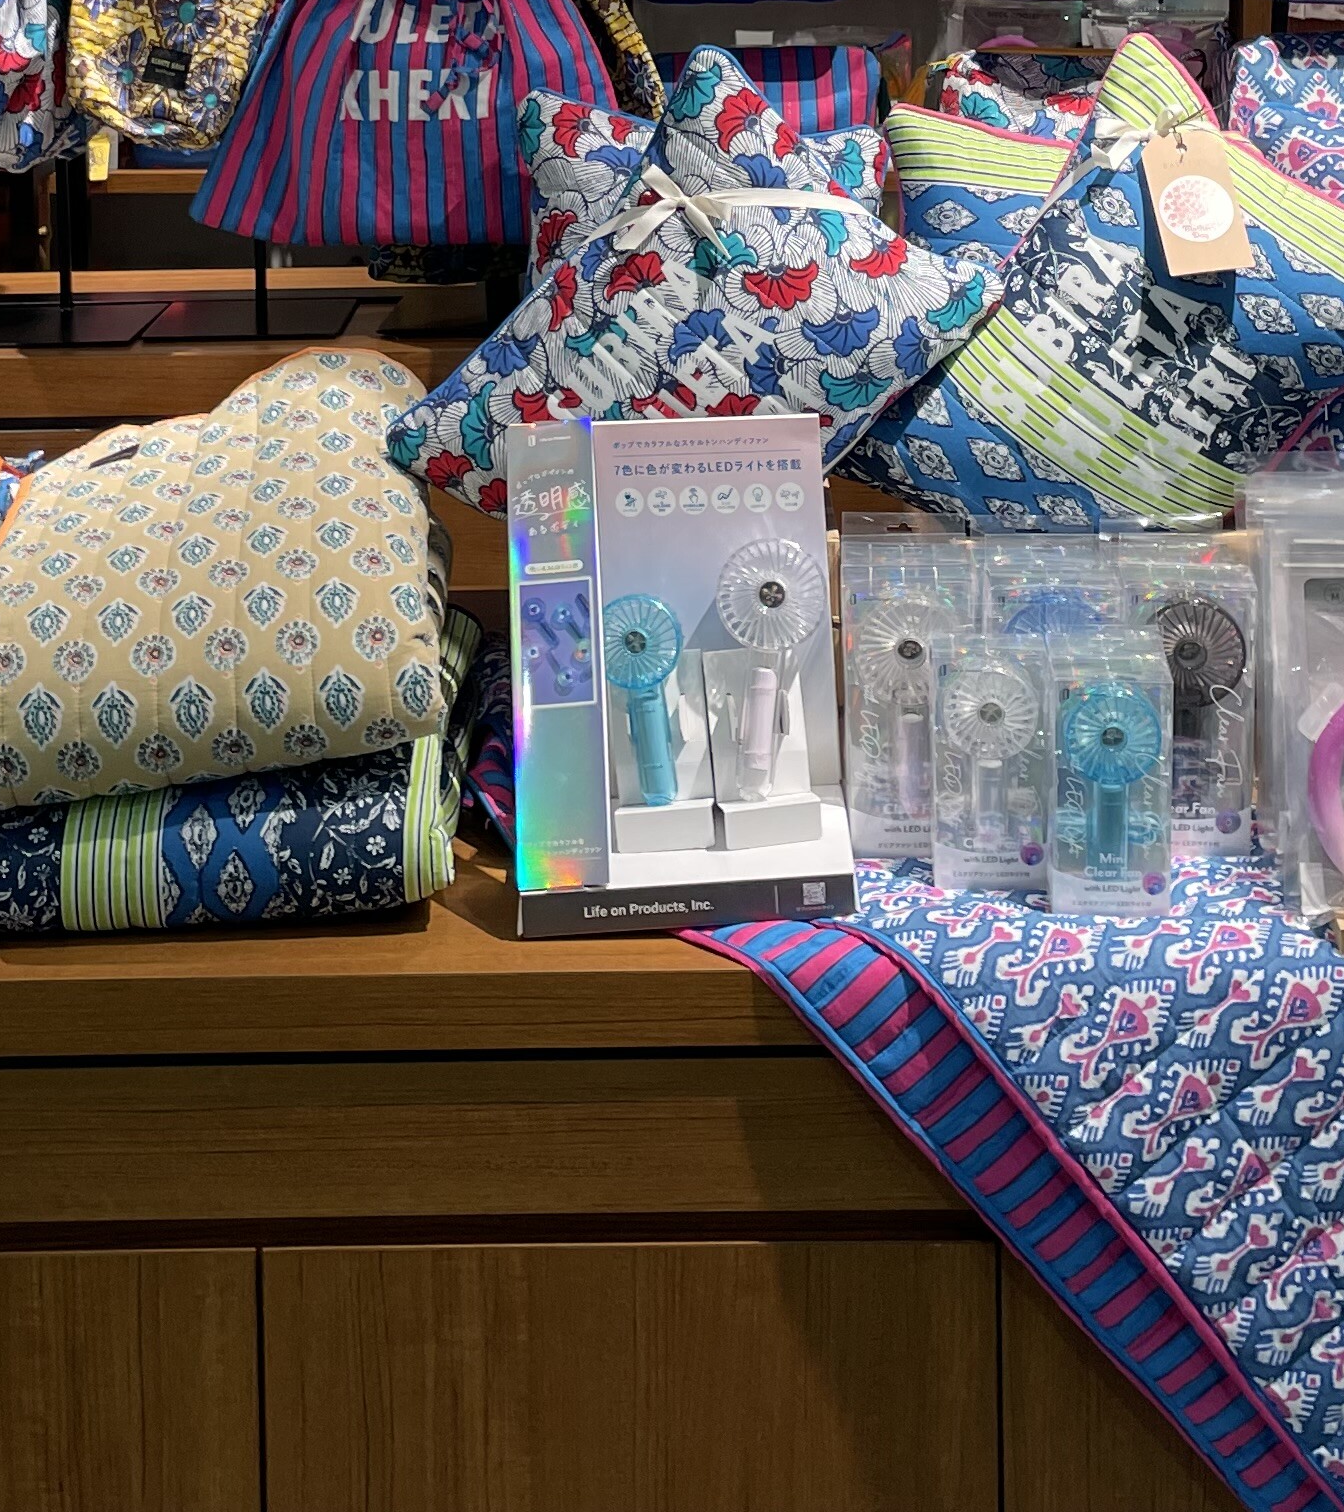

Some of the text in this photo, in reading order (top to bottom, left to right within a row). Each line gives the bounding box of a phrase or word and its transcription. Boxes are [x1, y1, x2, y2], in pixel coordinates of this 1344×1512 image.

[613, 459, 803, 477] 7色に色が変わるLEDライトを搭載
[583, 899, 715, 919] Life on Products, Inc.
